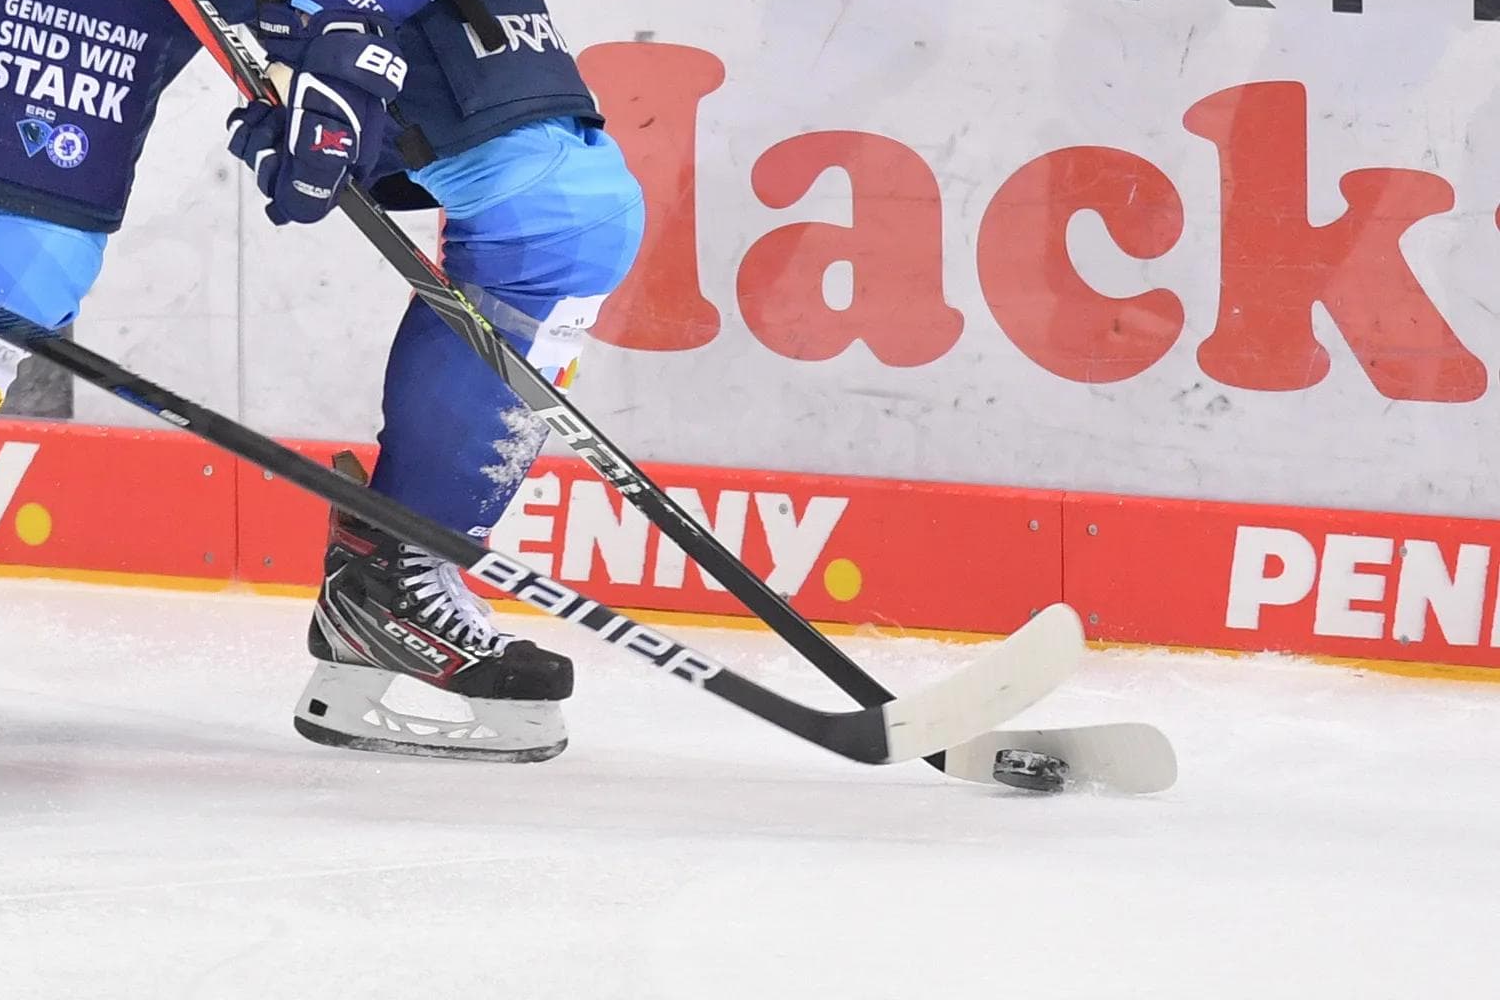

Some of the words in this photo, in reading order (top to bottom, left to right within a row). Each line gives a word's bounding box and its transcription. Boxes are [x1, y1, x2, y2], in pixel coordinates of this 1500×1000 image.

[80, 41, 137, 82] WIR
[25, 103, 58, 122] ERC
[383, 619, 449, 665] CCM
